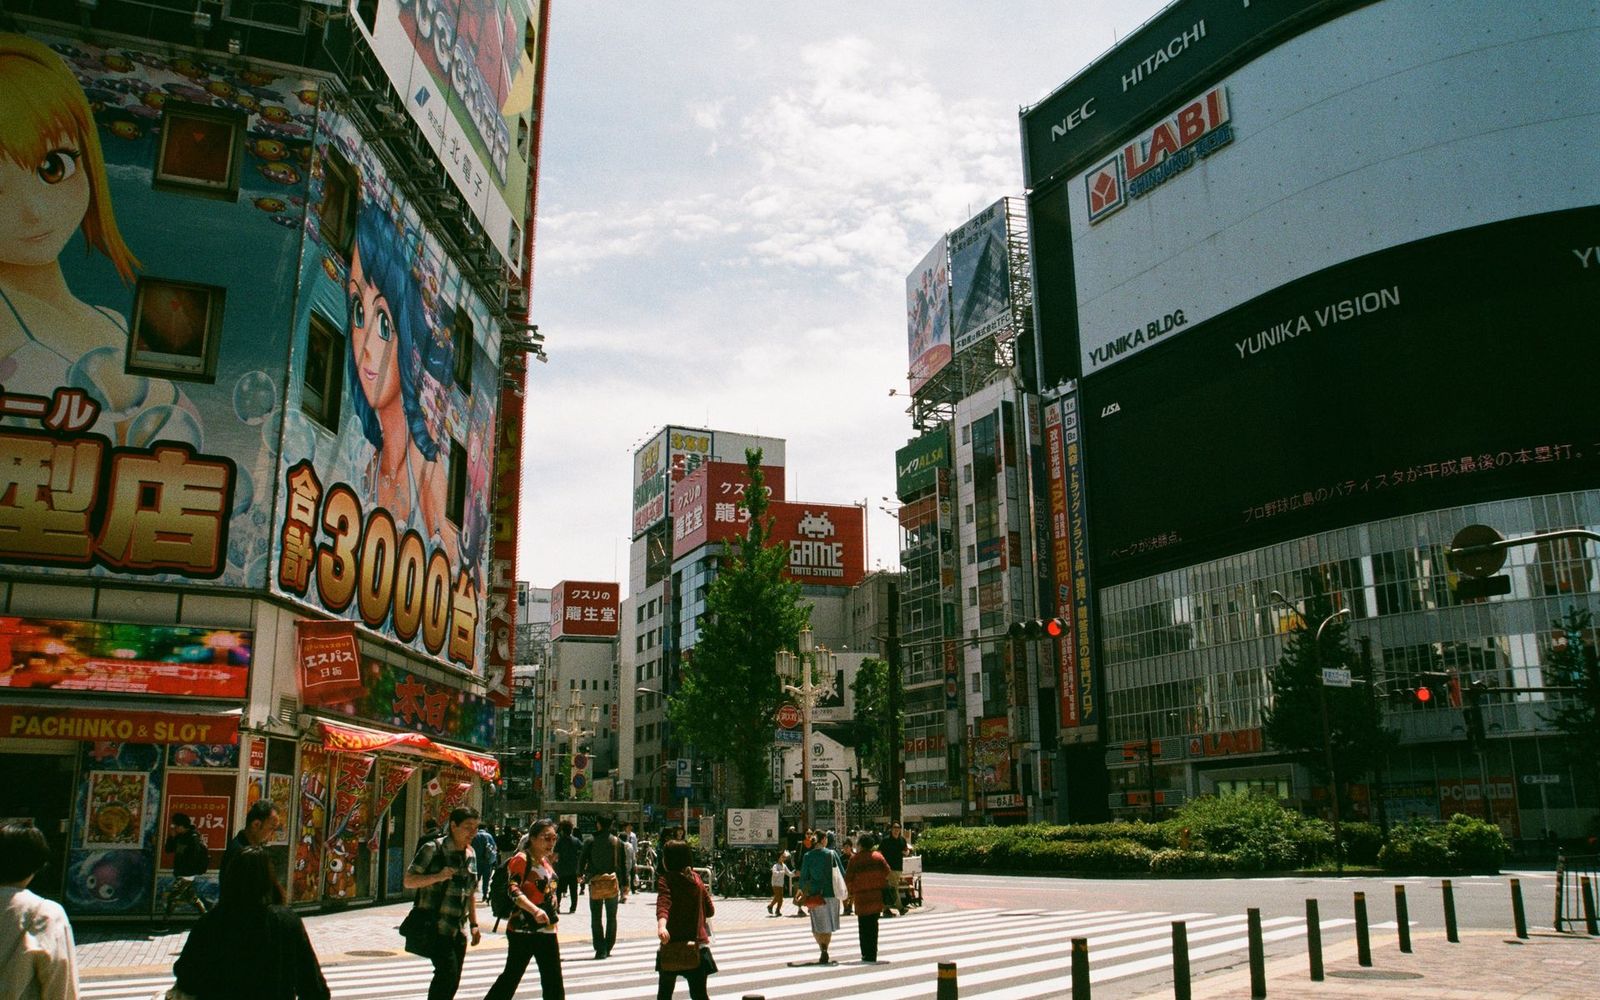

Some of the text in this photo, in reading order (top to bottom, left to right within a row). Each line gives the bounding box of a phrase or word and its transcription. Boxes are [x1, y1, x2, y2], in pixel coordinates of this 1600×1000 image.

[1122, 19, 1207, 92] HITACHI
[1051, 98, 1097, 141] NEC
[1124, 87, 1222, 181] LABI
[1571, 246, 1600, 268] Y
[1236, 286, 1400, 359] YUNIKA VISION
[1088, 309, 1188, 367] YUNIKA BLDG.
[1100, 402, 1121, 418] LISA
[789, 540, 844, 568] GAME
[790, 566, 844, 577] TAITO STATION
[571, 590, 611, 601] クスリの
[565, 606, 616, 622] 龍生堂
[305, 649, 355, 668] エスパス
[9, 715, 212, 743] PACHINKO & SLOT
